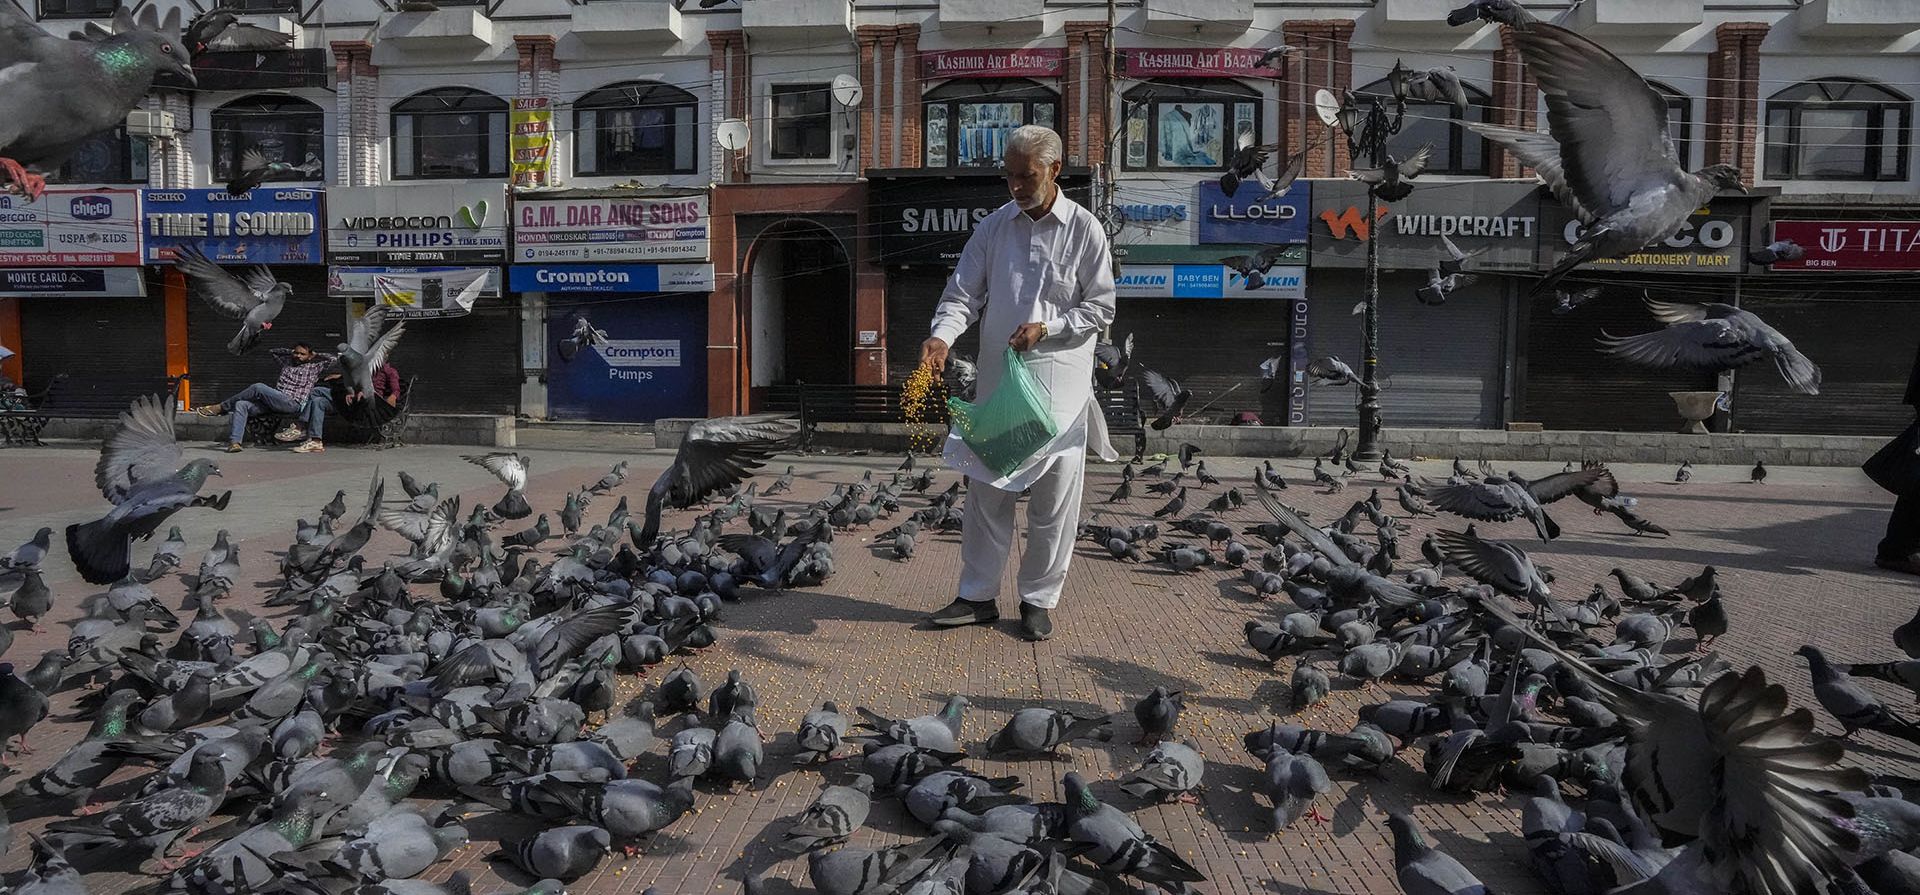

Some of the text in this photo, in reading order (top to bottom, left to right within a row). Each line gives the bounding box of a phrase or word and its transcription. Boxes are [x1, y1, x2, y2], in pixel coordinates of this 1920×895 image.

[938, 53, 1043, 69] KASHMIR ART BAZAR
[1138, 52, 1193, 68] KASHMIR
[1196, 52, 1219, 68] ART
[518, 99, 539, 109] SALE
[147, 193, 186, 201] SEIKO
[215, 192, 252, 201] CITIZEN
[275, 191, 313, 201] CASIO
[522, 201, 699, 228] G.M. DAR AND SONS
[1119, 204, 1187, 221] HILIPS
[1213, 204, 1296, 219] LLOYD
[146, 211, 315, 237] TIME N SOUND
[343, 216, 453, 230] VIDEOCON
[902, 207, 998, 232] SAMS
[1396, 214, 1536, 237] WILDCRAFT
[59, 233, 128, 243] USPA KIDS
[376, 232, 502, 247] PHILIPS TIME INDIA
[517, 233, 548, 242] HONDA
[549, 232, 587, 241] KIRLOSKAR
[675, 229, 705, 238] Crompton
[27, 254, 57, 262] STORES
[387, 252, 445, 261] TIME INDIA
[1621, 254, 1692, 265] STATIONERY
[1696, 254, 1731, 266] MART
[1805, 259, 1837, 267] BIG BEN
[7, 272, 67, 283] MONTE CARLO
[536, 269, 630, 286] Crompton
[1177, 274, 1219, 282] BABY BEN
[605, 346, 674, 361] Crompton
[609, 368, 653, 383] Pumps
